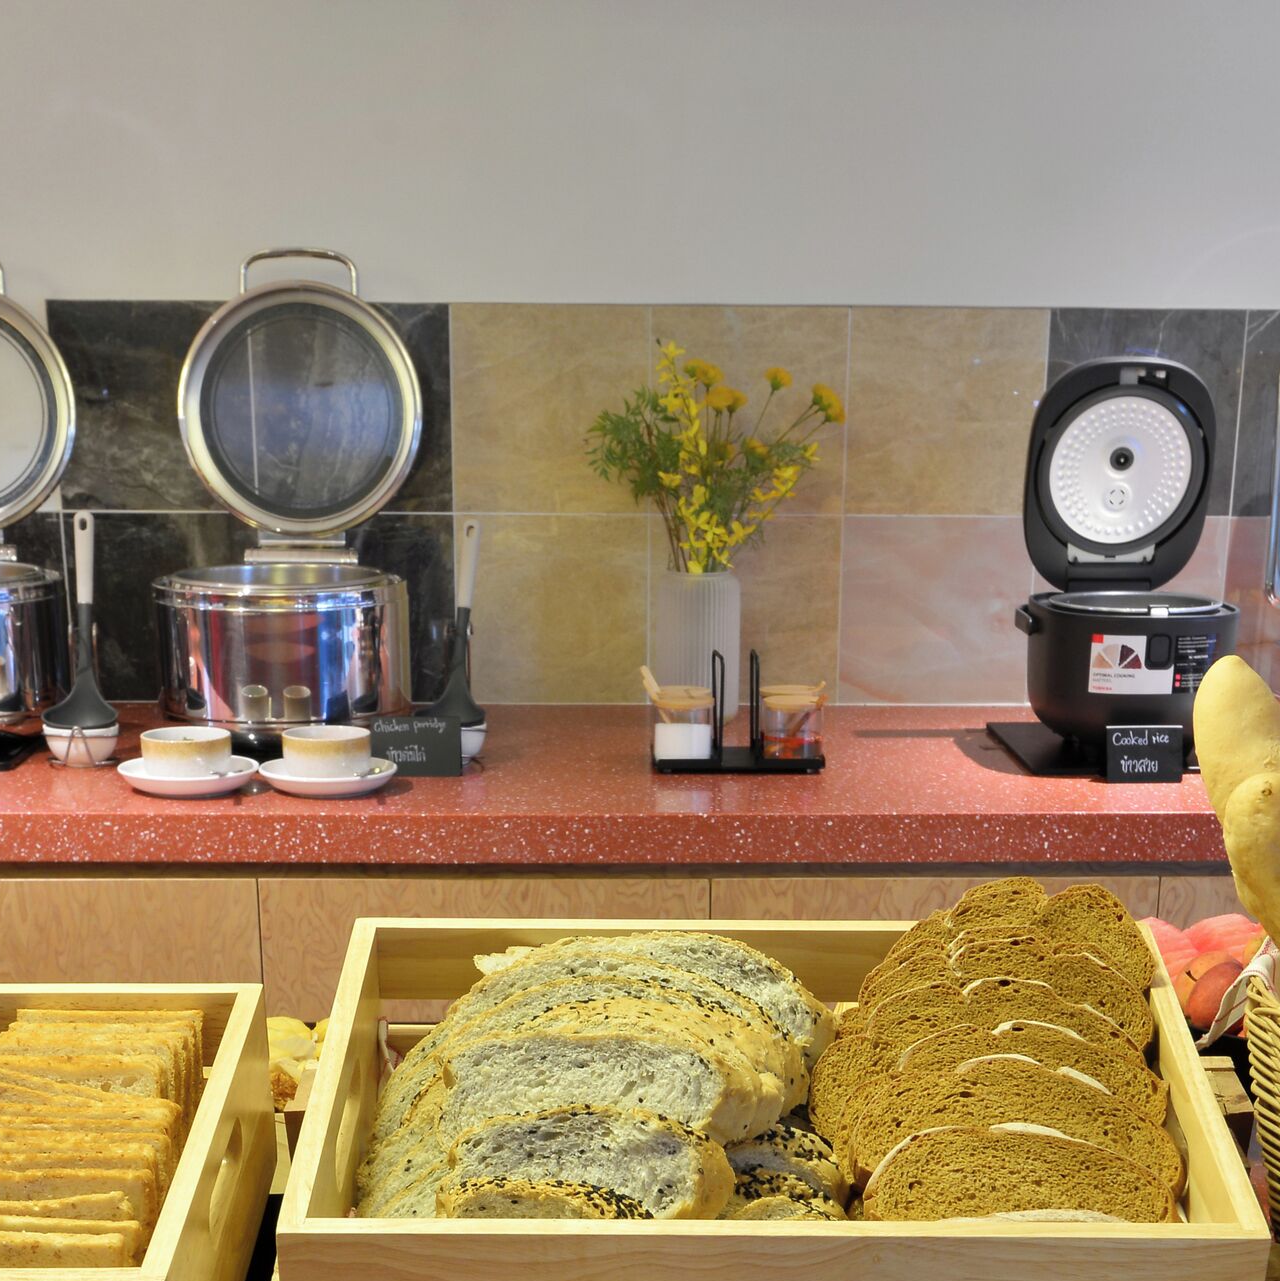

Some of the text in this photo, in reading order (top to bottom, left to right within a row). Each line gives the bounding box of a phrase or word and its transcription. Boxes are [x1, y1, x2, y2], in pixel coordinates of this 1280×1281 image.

[373, 719, 410, 733] Chicken
[1112, 729, 1170, 746] Cooked rice
